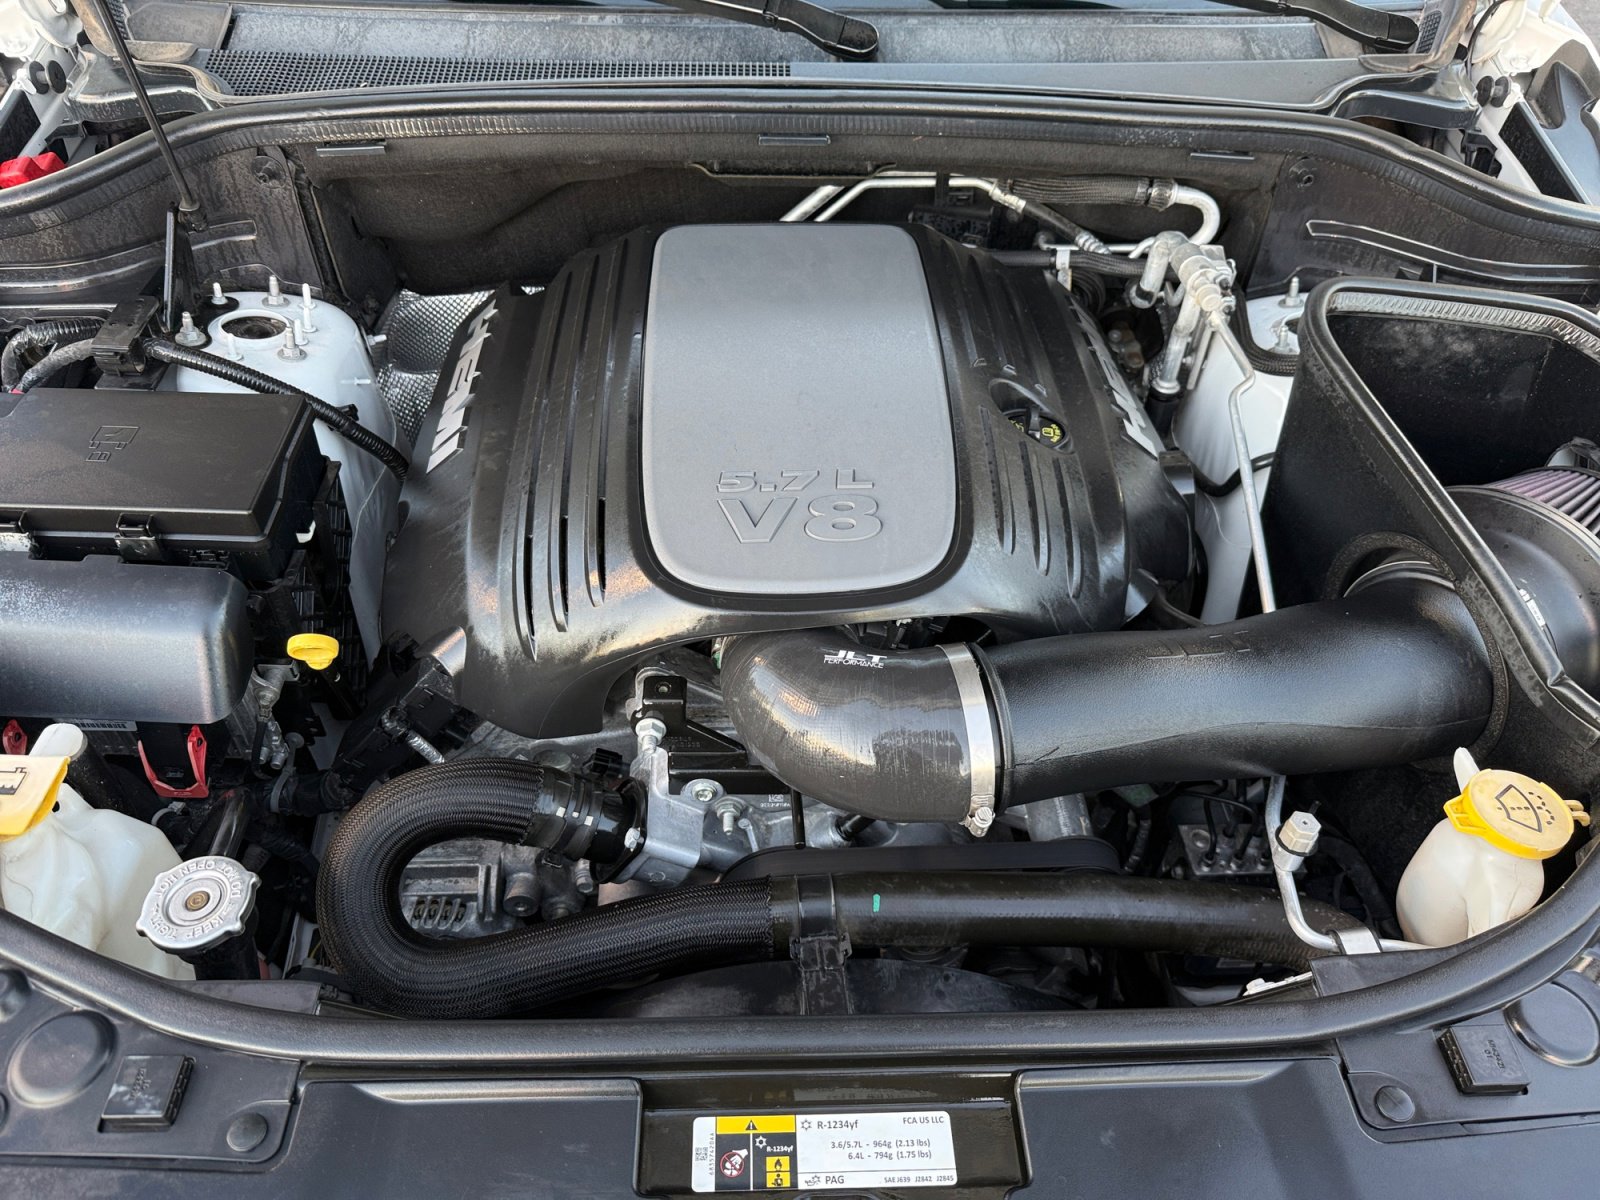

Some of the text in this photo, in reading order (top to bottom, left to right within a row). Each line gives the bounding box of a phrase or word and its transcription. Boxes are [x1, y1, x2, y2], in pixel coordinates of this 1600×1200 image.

[716, 494, 883, 543] V8
[823, 657, 885, 669] PERFORMANCE
[824, 650, 888, 664] JLT
[180, 859, 216, 877] OPEN
[184, 915, 224, 941] KEEP
[817, 1119, 859, 1131] R-1234yf
[902, 1115, 945, 1125] FCA US LLC
[766, 1145, 794, 1153] R-1234yf
[831, 1140, 863, 1150] 3.6/5.7L
[872, 1140, 892, 1149] 964g
[895, 1139, 915, 1148] (2.13
[916, 1138, 931, 1147] lbs)
[848, 1151, 865, 1160] 6.4L
[874, 1151, 893, 1161] 794g
[896, 1150, 916, 1160] (1.75
[917, 1149, 932, 1159] lbs)
[825, 1175, 845, 1185] PAG
[884, 1176, 896, 1184] SAE
[915, 1175, 932, 1183] J2842
